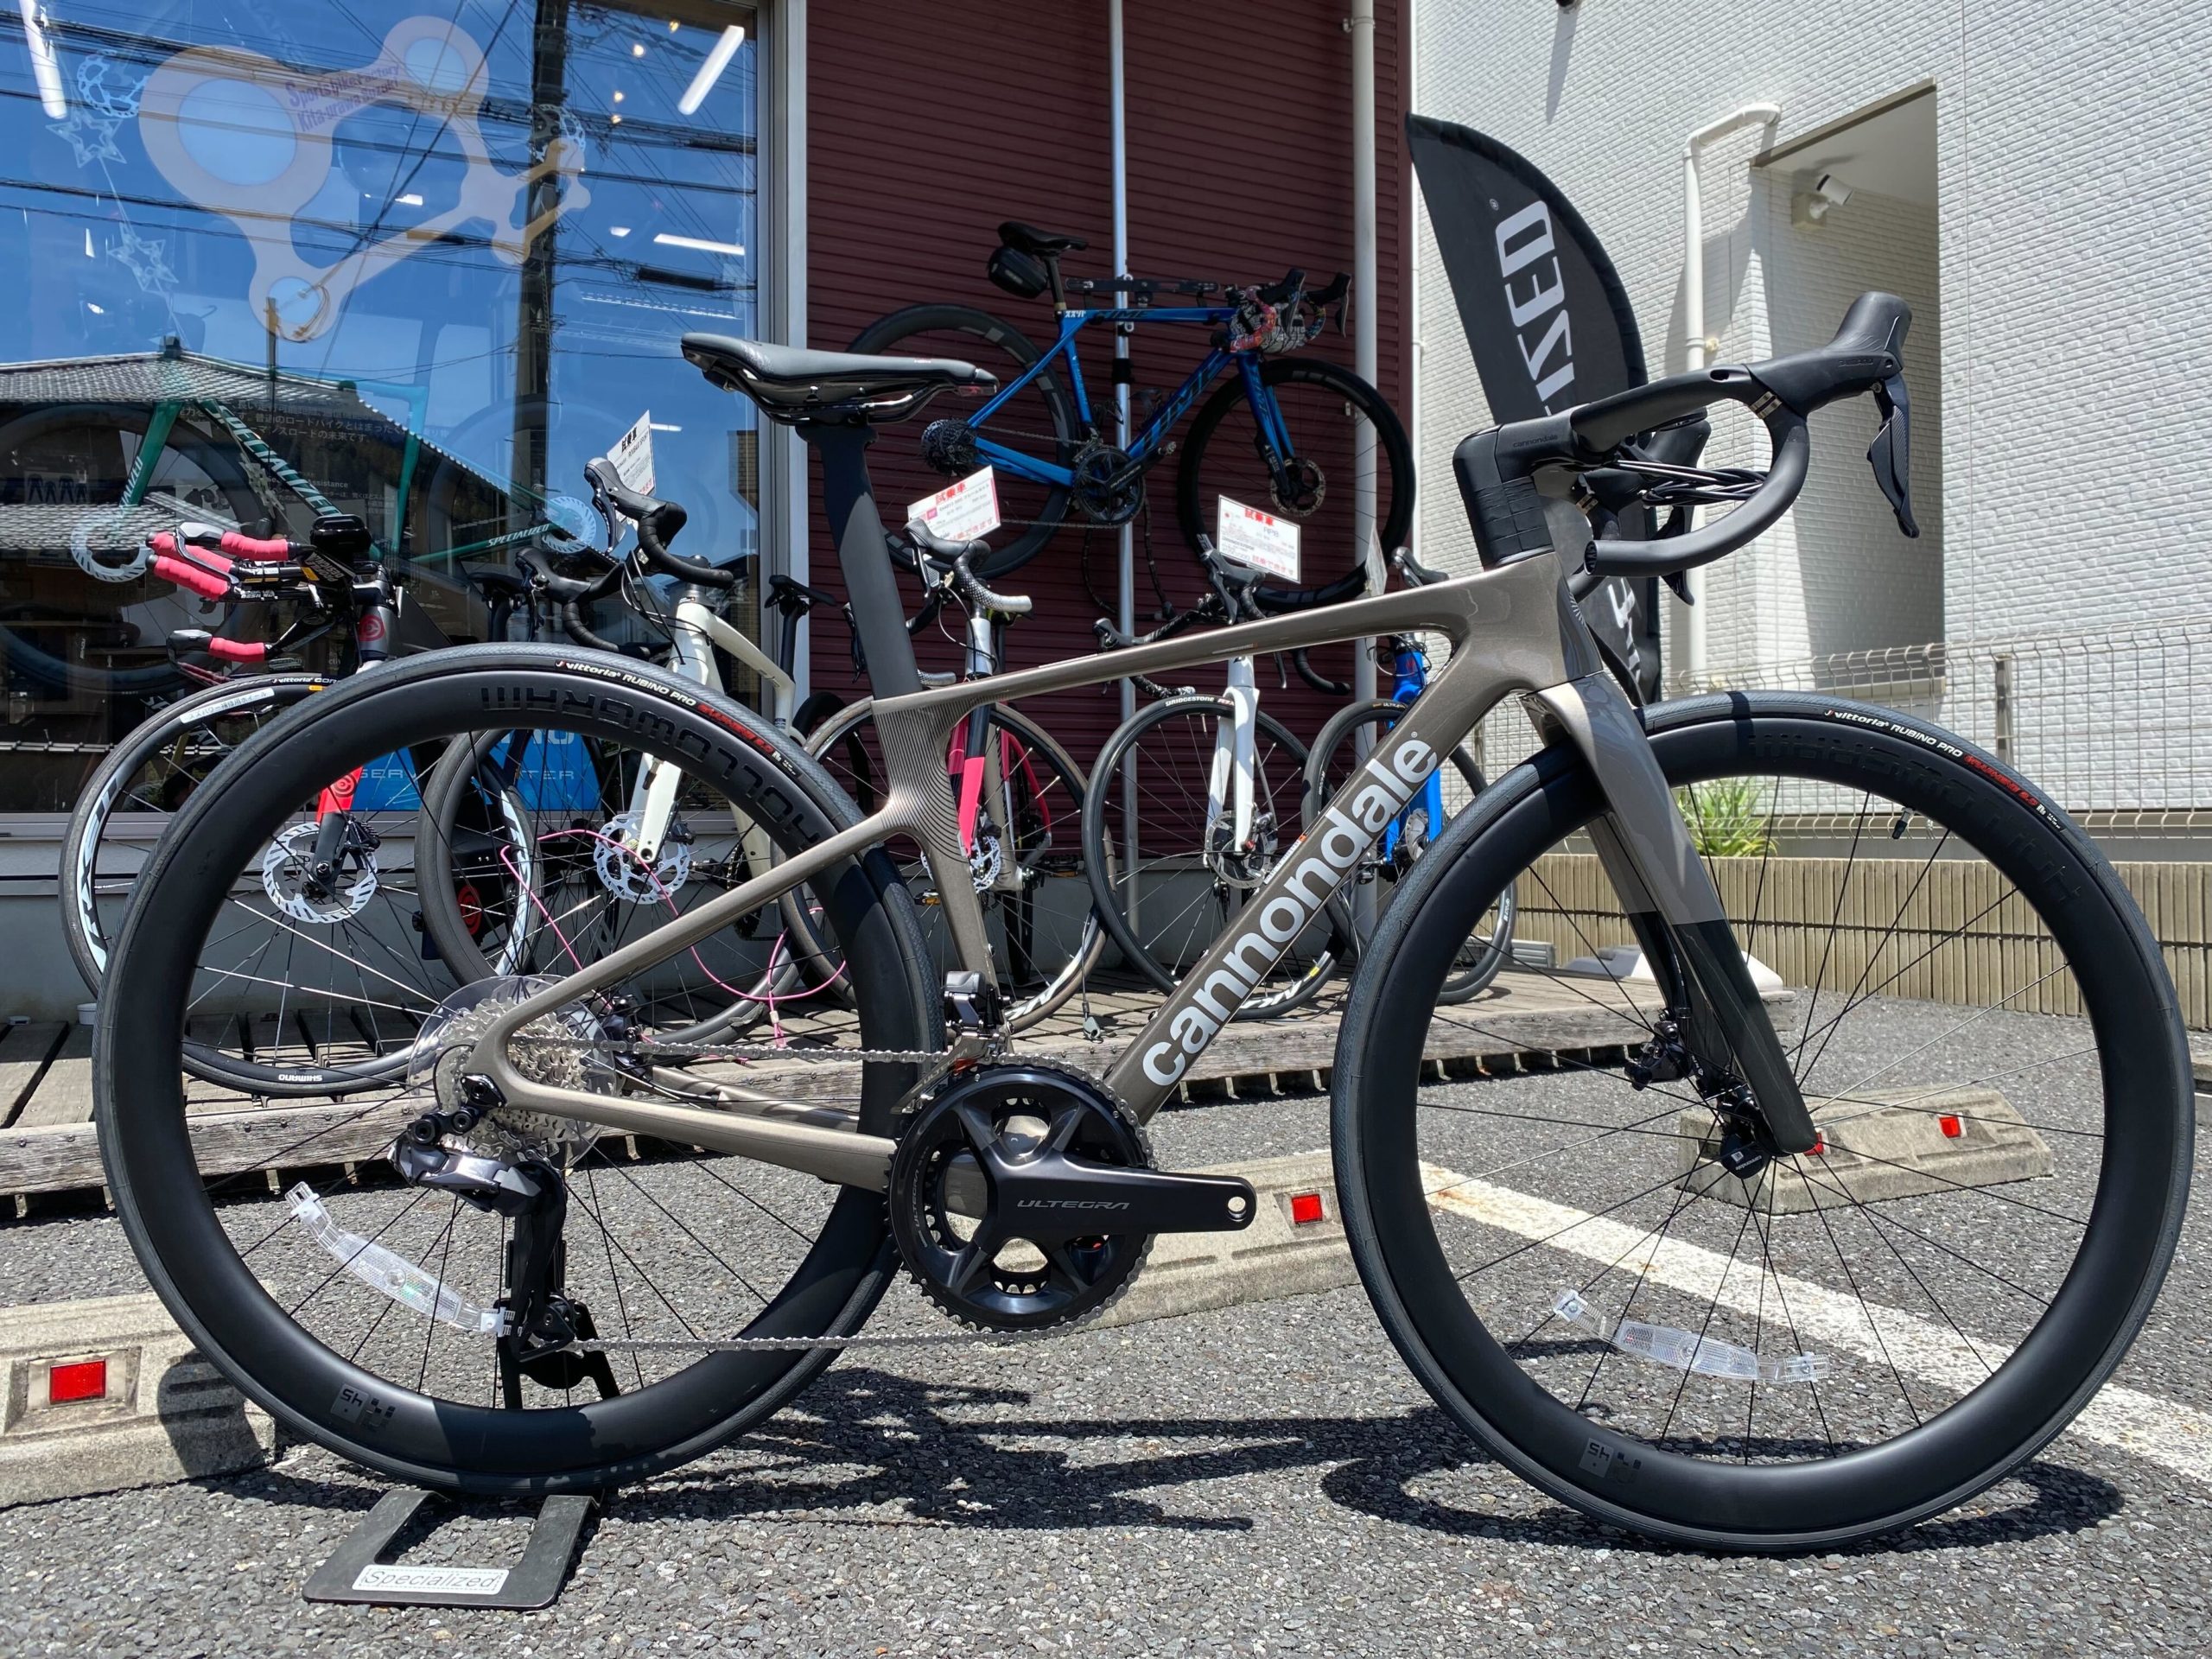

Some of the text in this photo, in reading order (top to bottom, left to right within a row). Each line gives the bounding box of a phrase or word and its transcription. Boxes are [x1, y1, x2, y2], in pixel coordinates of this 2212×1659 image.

[1496, 200, 1574, 416] IZED
[1513, 435, 1558, 448] cannondale
[486, 524, 550, 547] SPECIALIZED
[622, 674, 669, 695] RUBINO
[670, 692, 696, 706] PRO
[1165, 696, 1215, 707] BRIDGESTONE
[1891, 724, 1936, 746] RUBINO
[1937, 742, 1963, 758] PRO
[480, 685, 821, 852] HOLLOWGRAM
[1142, 739, 1438, 1087] cannondale
[1017, 1199, 1130, 1211] ULTEGRA
[365, 1570, 499, 1588] Specialized
